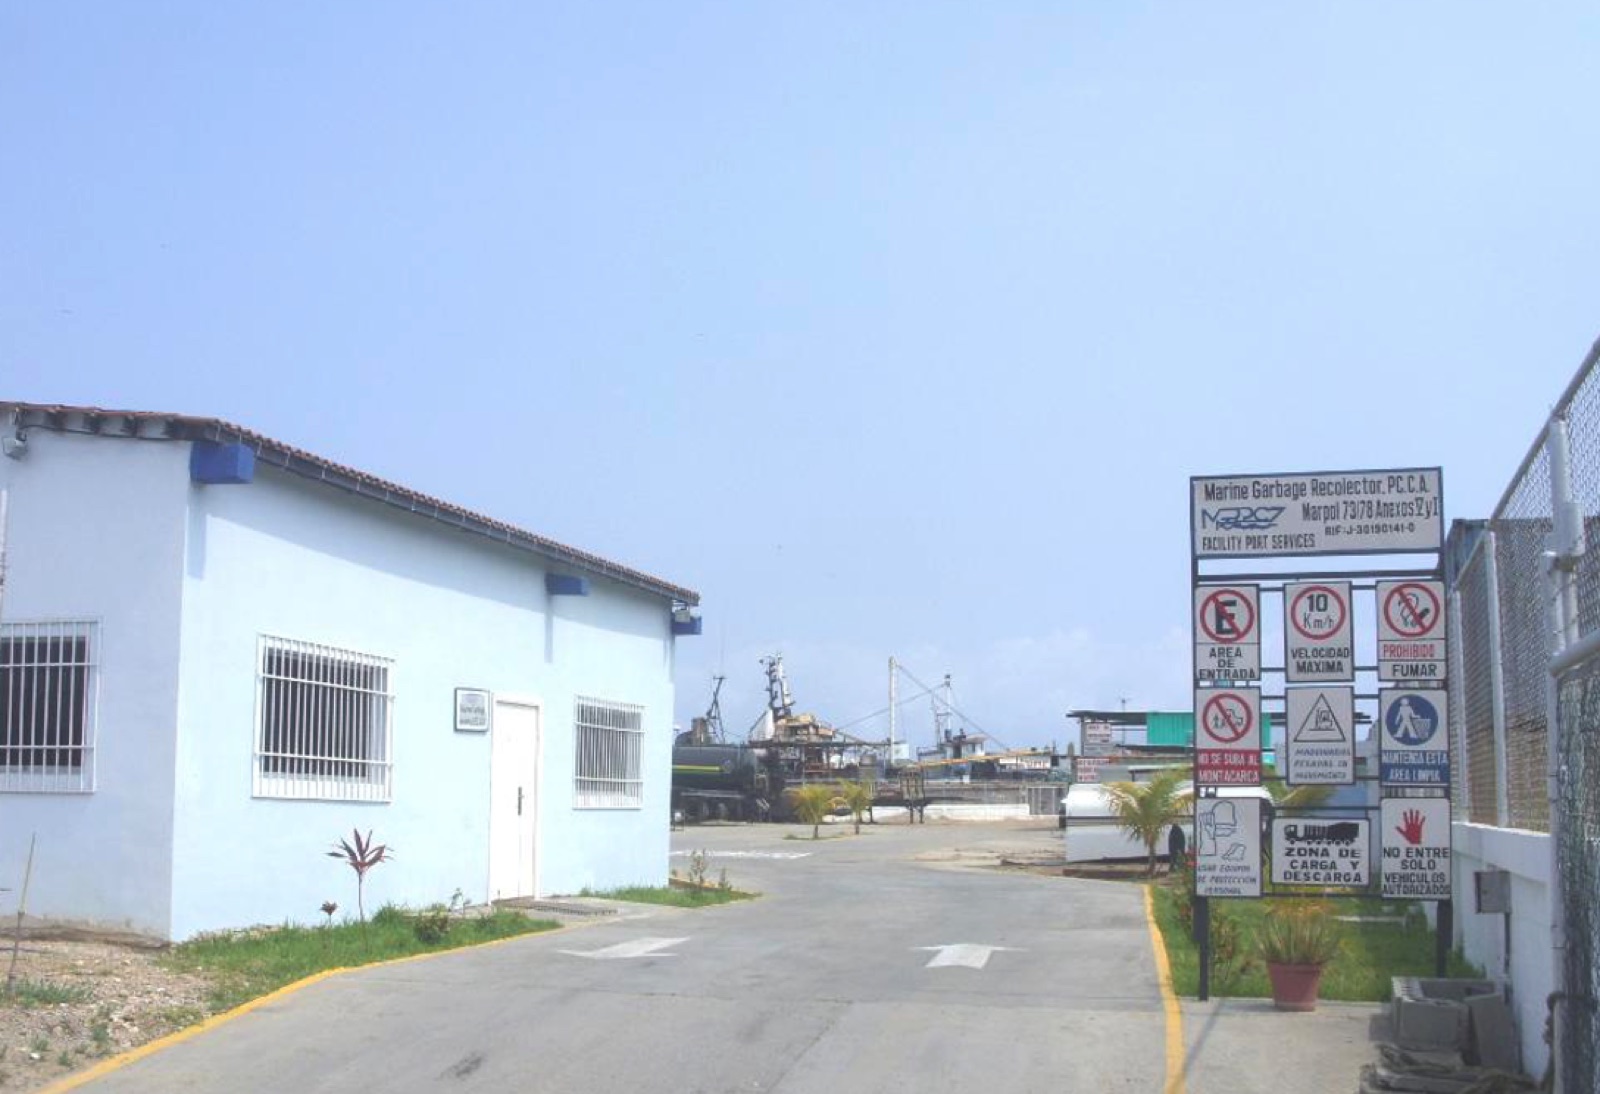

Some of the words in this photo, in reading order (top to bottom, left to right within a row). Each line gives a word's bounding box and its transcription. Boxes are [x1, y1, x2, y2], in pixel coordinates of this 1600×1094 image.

[1204, 482, 1248, 501] Marine
[1252, 480, 1307, 501] Garbage
[1302, 501, 1340, 524] Marpol
[1375, 500, 1414, 518] Anexos
[1202, 536, 1242, 551] FACILITY
[1245, 534, 1269, 550] PORT
[1271, 533, 1316, 549] SERVICES
[1306, 593, 1329, 613] 10
[1209, 646, 1243, 659] AREA
[1290, 646, 1350, 660] VELOCIDAD
[1383, 643, 1436, 659] PROHIBIDO
[1217, 659, 1236, 668] DE
[1296, 660, 1344, 674] MAXIMA
[1199, 668, 1257, 680] ENTRADA
[1392, 664, 1438, 678] FUMAR
[1284, 846, 1330, 858] ZONA
[1338, 848, 1361, 859] DE
[1383, 847, 1400, 859] NO
[1405, 847, 1450, 858] ENTRE
[1289, 860, 1338, 870] CARGA
[1350, 861, 1360, 870] Y
[1401, 858, 1436, 870] SOLO
[1283, 870, 1363, 883] DESCARGA
[1384, 871, 1446, 884] VEHICULOS
